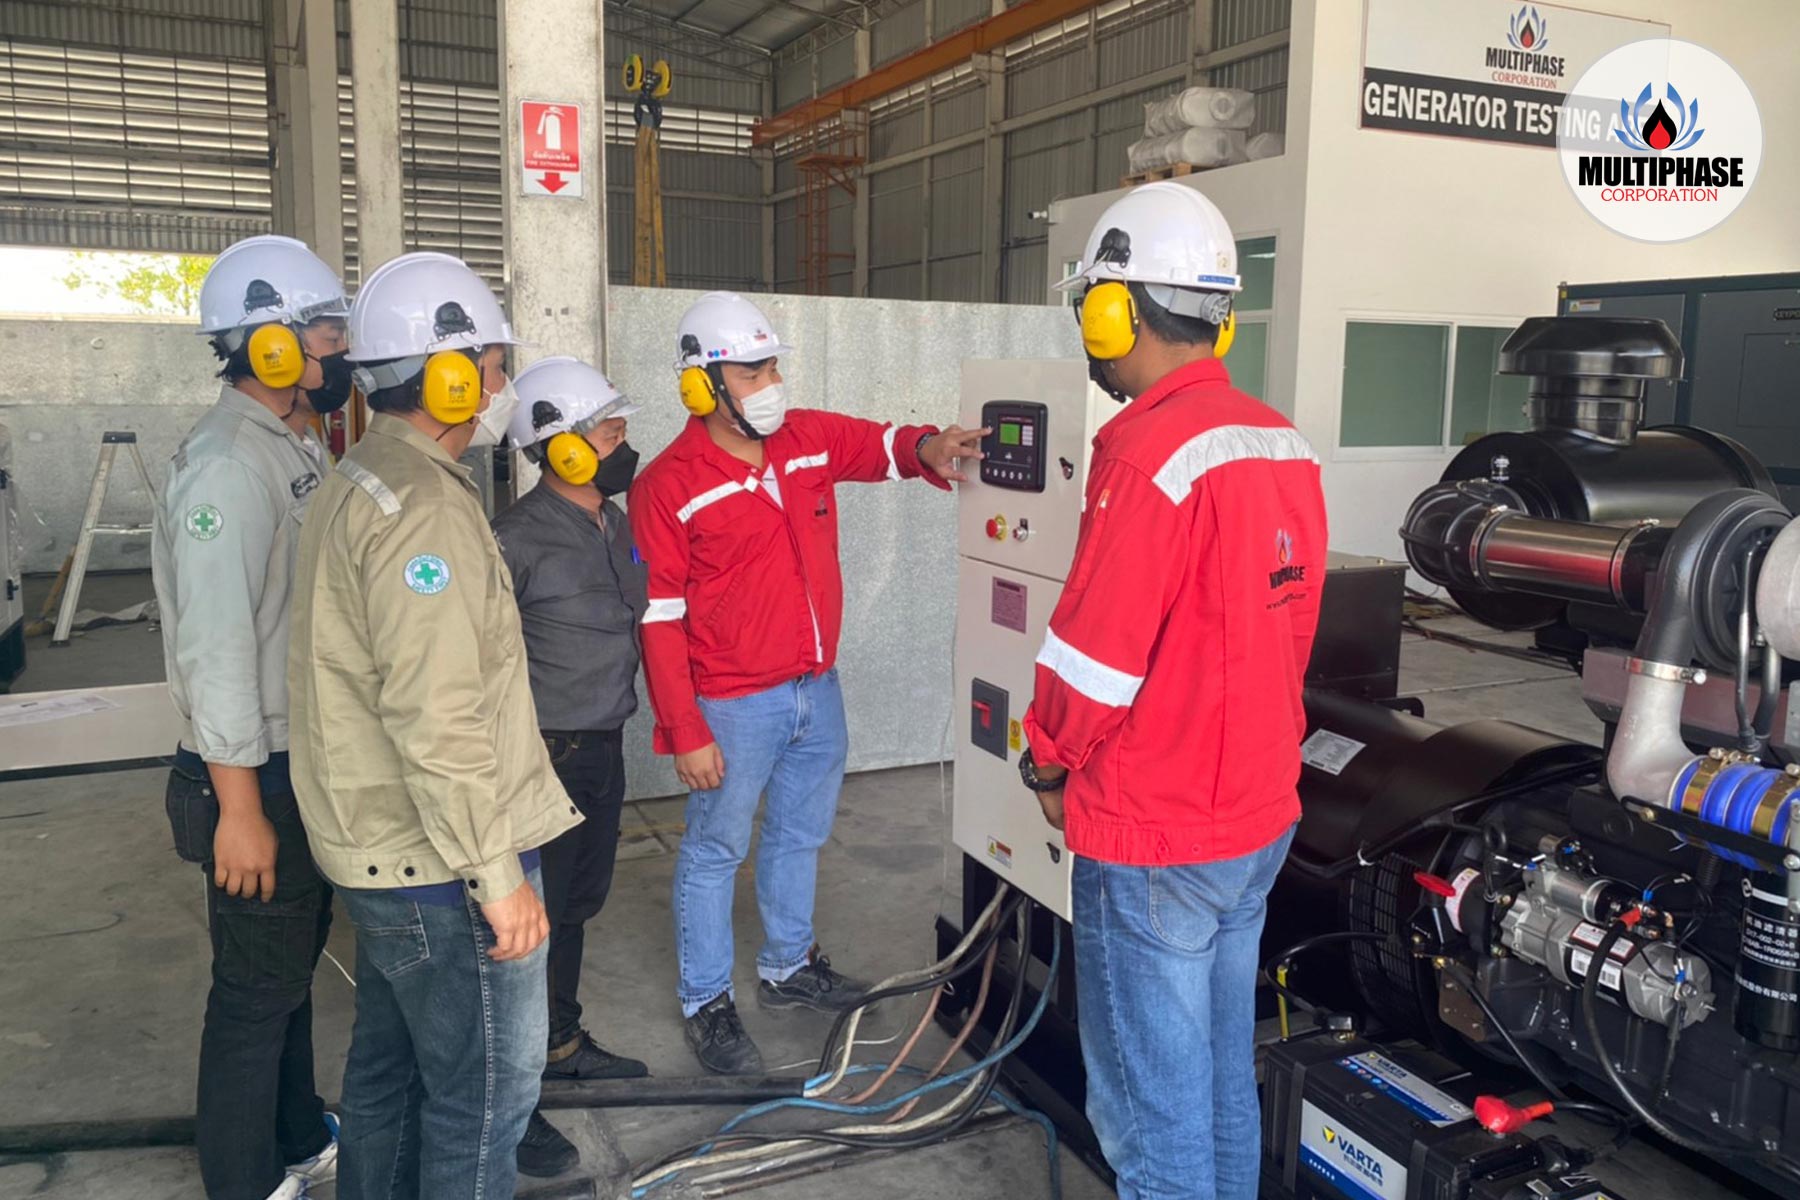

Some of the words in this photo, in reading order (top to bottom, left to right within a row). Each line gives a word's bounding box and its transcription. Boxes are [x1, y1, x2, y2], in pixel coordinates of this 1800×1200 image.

[1485, 47, 1565, 77] MULTIPHASE
[1491, 71, 1557, 89] CORPORATION
[1364, 81, 1507, 130] GENERATOR
[1513, 100, 1601, 139] TESTING
[1337, 1135, 1384, 1179] VARTA
